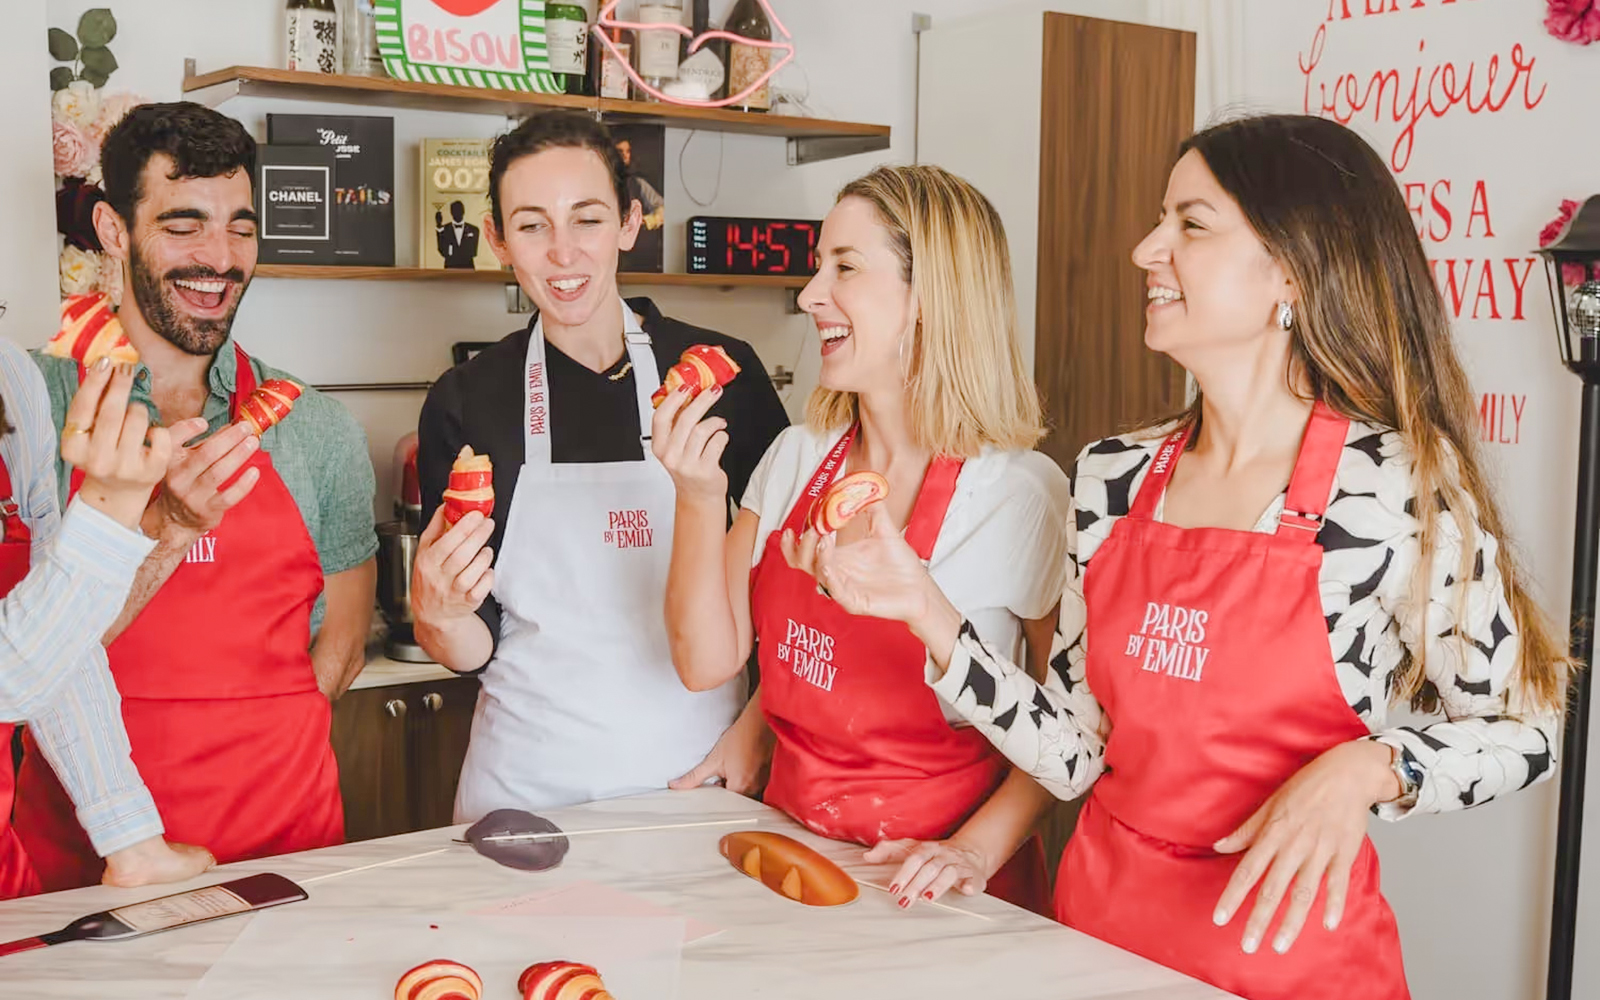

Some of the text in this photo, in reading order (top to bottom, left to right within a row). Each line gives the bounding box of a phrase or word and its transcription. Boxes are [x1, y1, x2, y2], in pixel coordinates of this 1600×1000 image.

[408, 23, 519, 69] BISOU
[269, 190, 323, 202] CHANEL
[434, 167, 489, 189] 007
[1465, 179, 1496, 238] A
[726, 223, 815, 272] 14:57
[529, 362, 546, 435] PARIS BY EMILY
[1479, 393, 1526, 444] ILY
[808, 472, 829, 497] PARIS
[825, 459, 837, 470] BY
[1153, 444, 1176, 474] PARIS
[604, 528, 653, 549] BY EMILY
[609, 509, 649, 531] PARIS
[186, 536, 217, 563] ILY
[785, 618, 835, 662] PARIS
[1140, 602, 1209, 647] PARIS
[777, 642, 838, 692] BY EMILY
[1124, 634, 1211, 682] BY EMILY
